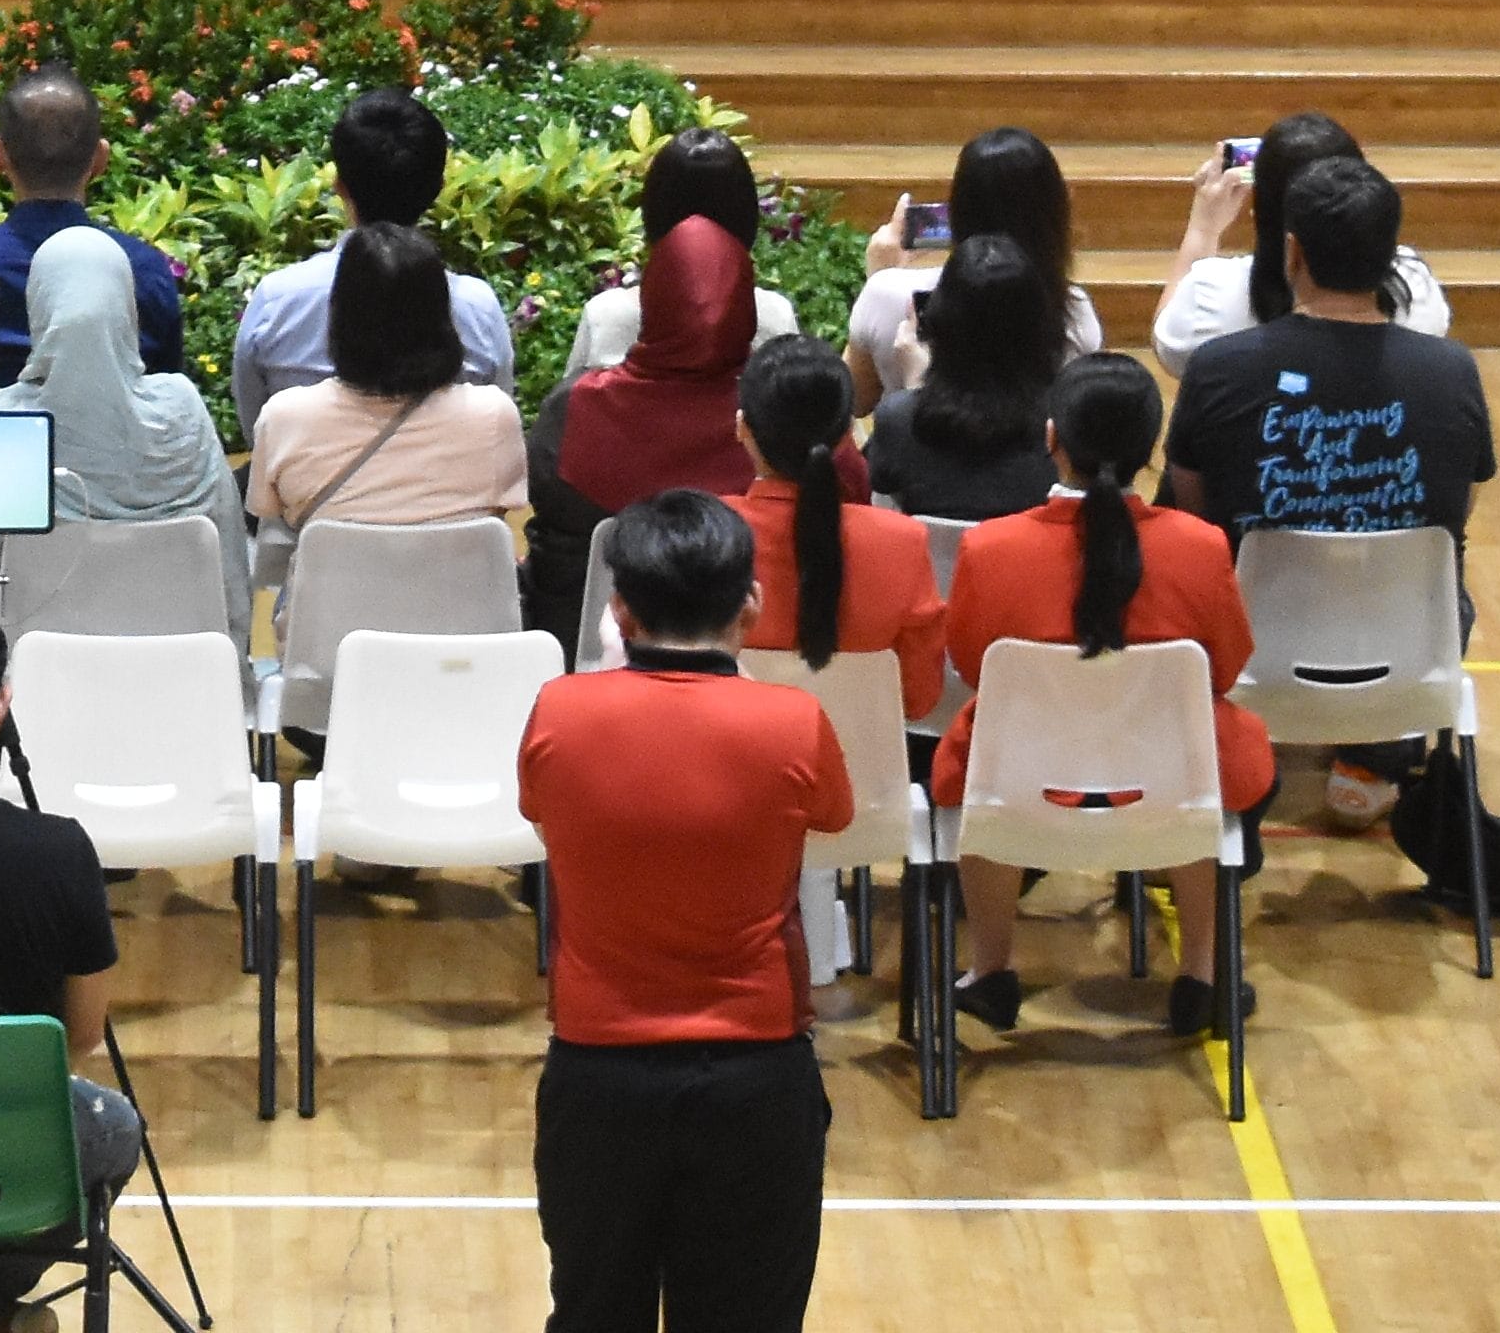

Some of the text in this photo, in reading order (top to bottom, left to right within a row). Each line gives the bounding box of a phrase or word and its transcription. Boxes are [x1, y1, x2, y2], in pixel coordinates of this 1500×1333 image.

[1263, 402, 1405, 447] Empowering
[1304, 428, 1358, 462] And
[1256, 447, 1419, 493] Transforming
[1264, 480, 1425, 519] Communities
